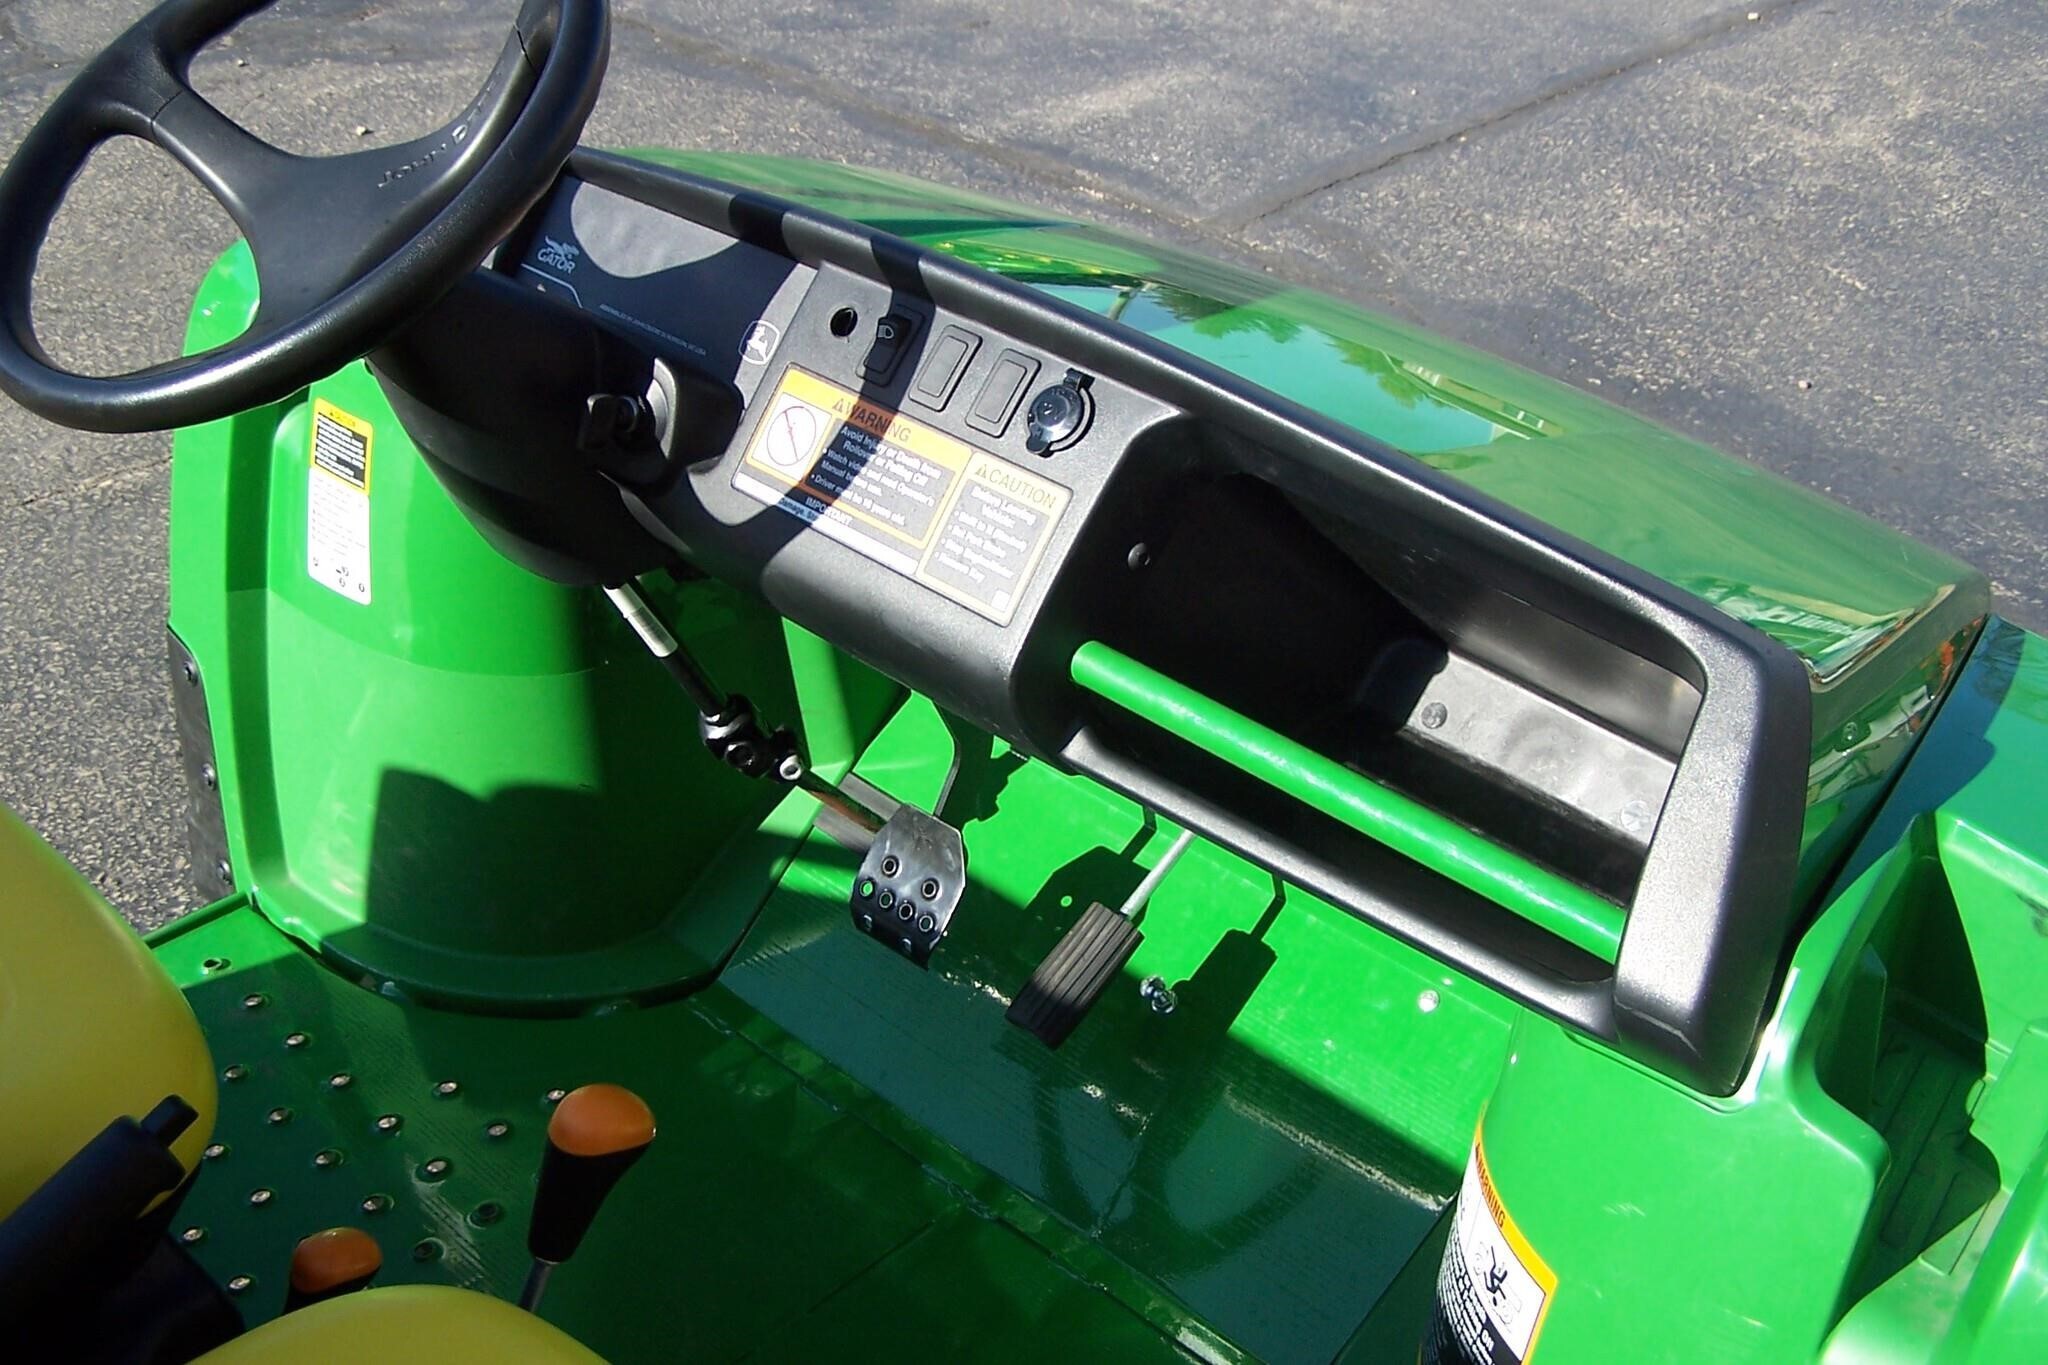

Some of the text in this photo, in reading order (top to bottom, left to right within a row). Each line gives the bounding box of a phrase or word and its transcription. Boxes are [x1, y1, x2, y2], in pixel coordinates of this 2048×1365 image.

[538, 247, 576, 275] GATOR
[844, 402, 912, 442] WARNING
[840, 425, 864, 442] Avoid
[861, 435, 888, 455] Injury
[842, 439, 877, 463] Rollover
[820, 460, 846, 478] Manual
[826, 449, 848, 465] Watch
[814, 473, 836, 490] Driver
[987, 467, 1057, 509] CAUTION
[804, 495, 853, 527] IMPORTANT
[1477, 1158, 1506, 1228] WARNING
